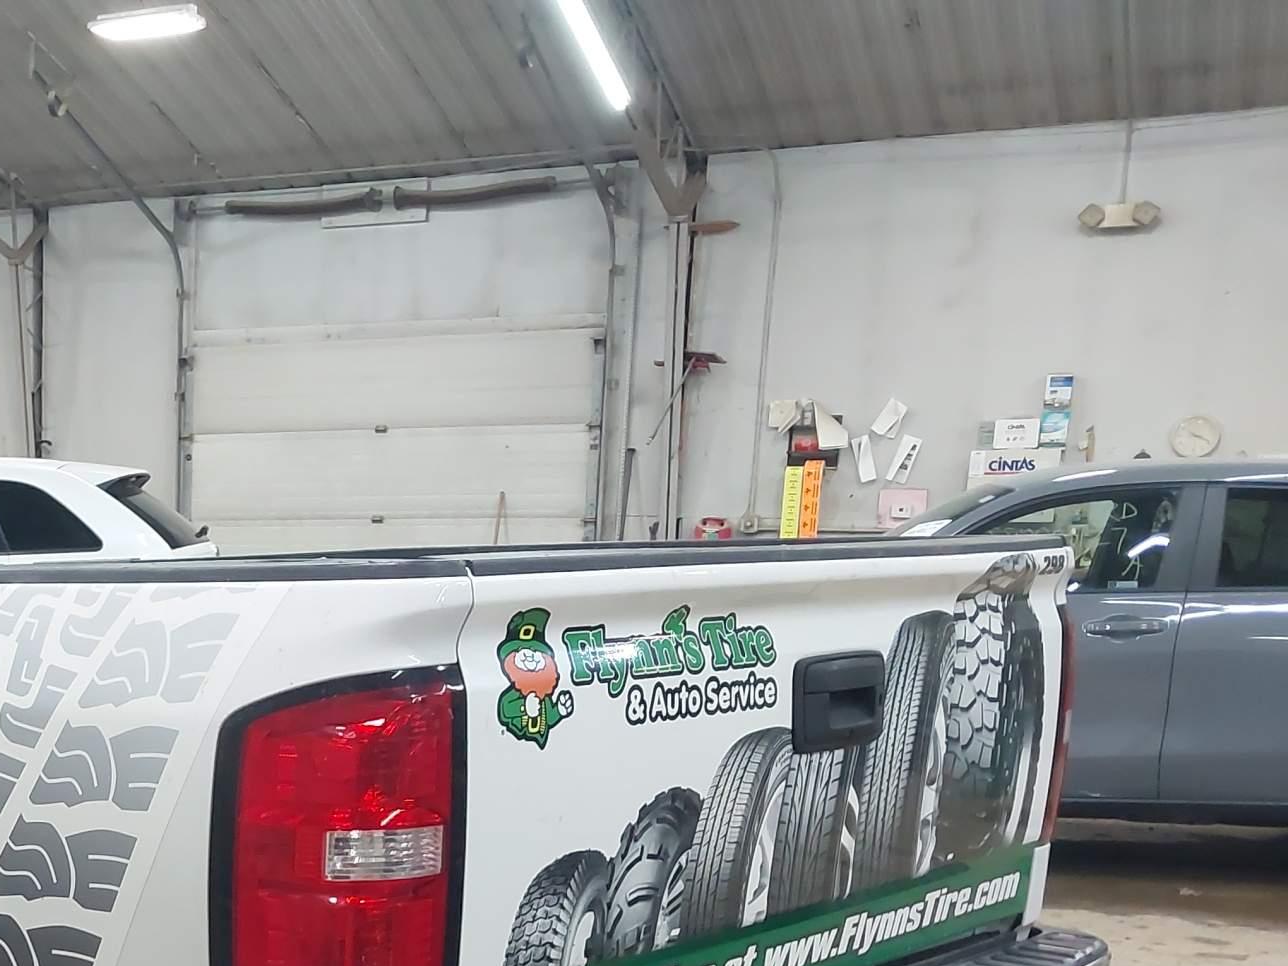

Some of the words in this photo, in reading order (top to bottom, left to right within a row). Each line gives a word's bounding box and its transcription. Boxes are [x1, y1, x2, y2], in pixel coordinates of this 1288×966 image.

[1040, 555, 1065, 575] 298
[563, 608, 705, 696] Flynn's
[700, 614, 776, 668] Tire
[626, 685, 647, 724] &
[652, 682, 702, 720] Auto
[707, 675, 777, 713] Service
